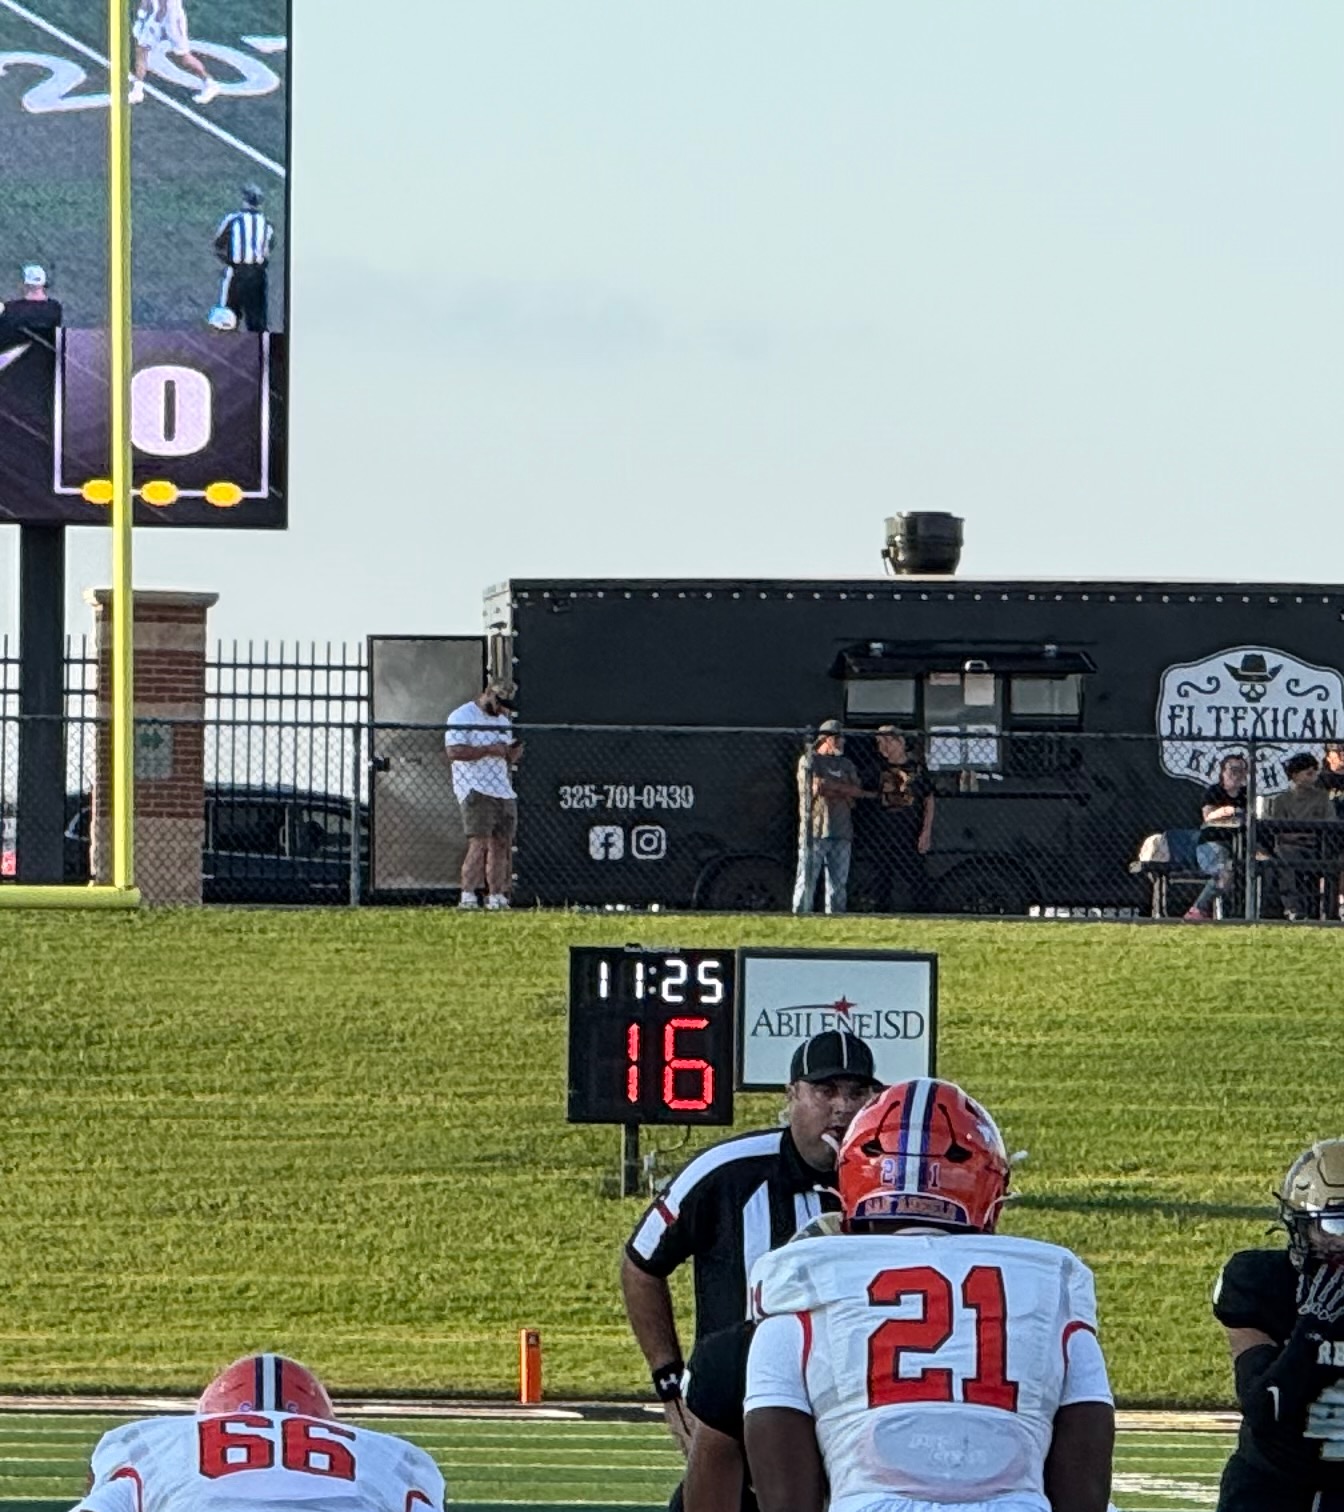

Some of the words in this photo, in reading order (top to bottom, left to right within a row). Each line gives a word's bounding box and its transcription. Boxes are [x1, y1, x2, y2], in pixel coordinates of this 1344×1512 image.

[131, 365, 211, 456] 0
[1168, 704, 1203, 737] EL
[1207, 706, 1337, 738] TEXICAN
[599, 960, 723, 1003] 11:25
[627, 1018, 714, 1111] 16
[866, 1265, 1019, 1412] 21
[198, 1413, 357, 1481] 66
